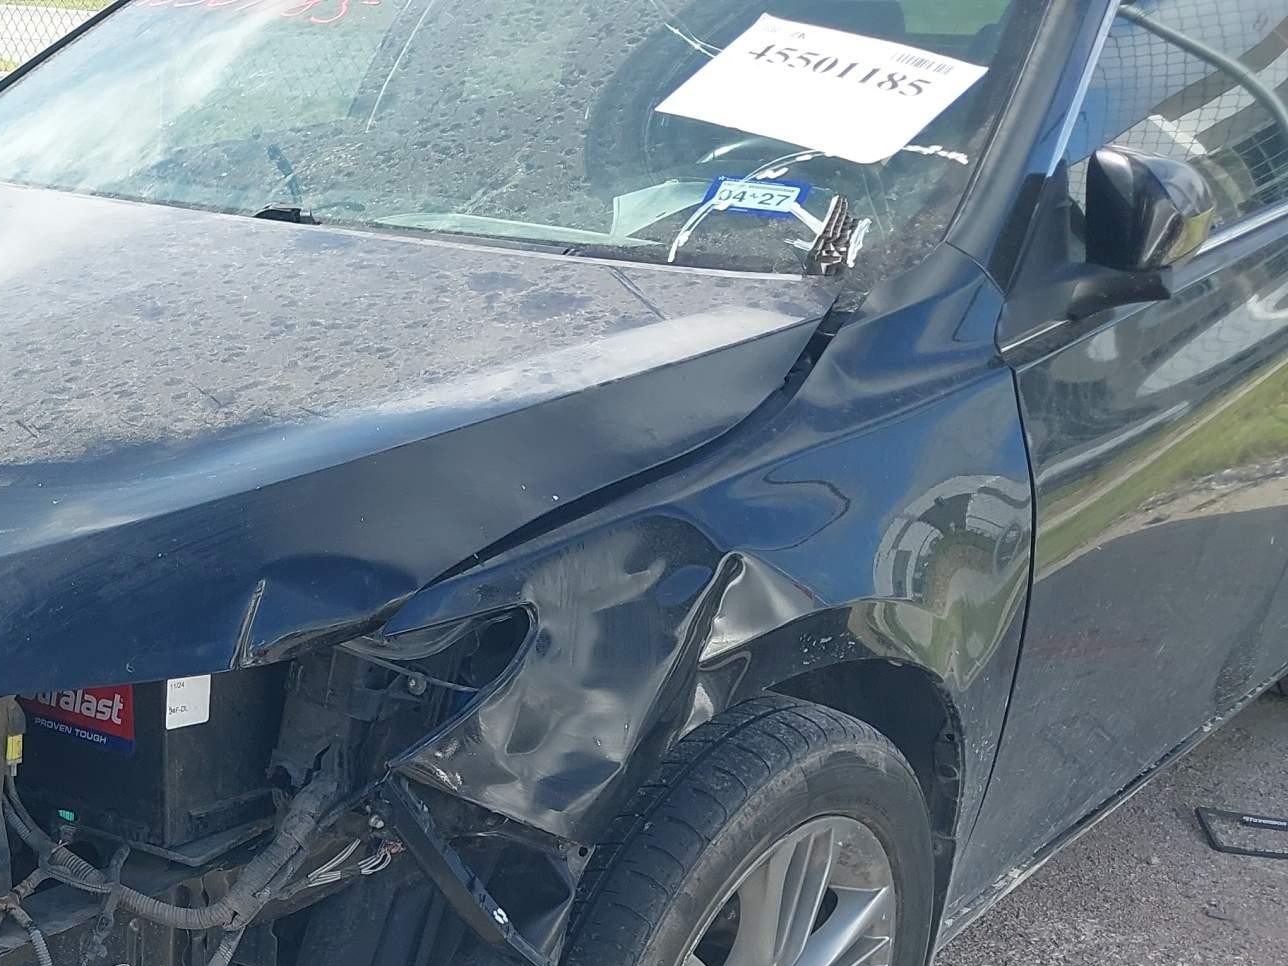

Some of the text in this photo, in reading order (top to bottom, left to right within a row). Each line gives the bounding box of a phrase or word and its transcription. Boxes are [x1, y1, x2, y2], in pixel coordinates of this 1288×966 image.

[748, 44, 931, 96] 45501185
[23, 688, 123, 725] uralast
[34, 717, 107, 744] PROVEN TOUGH
